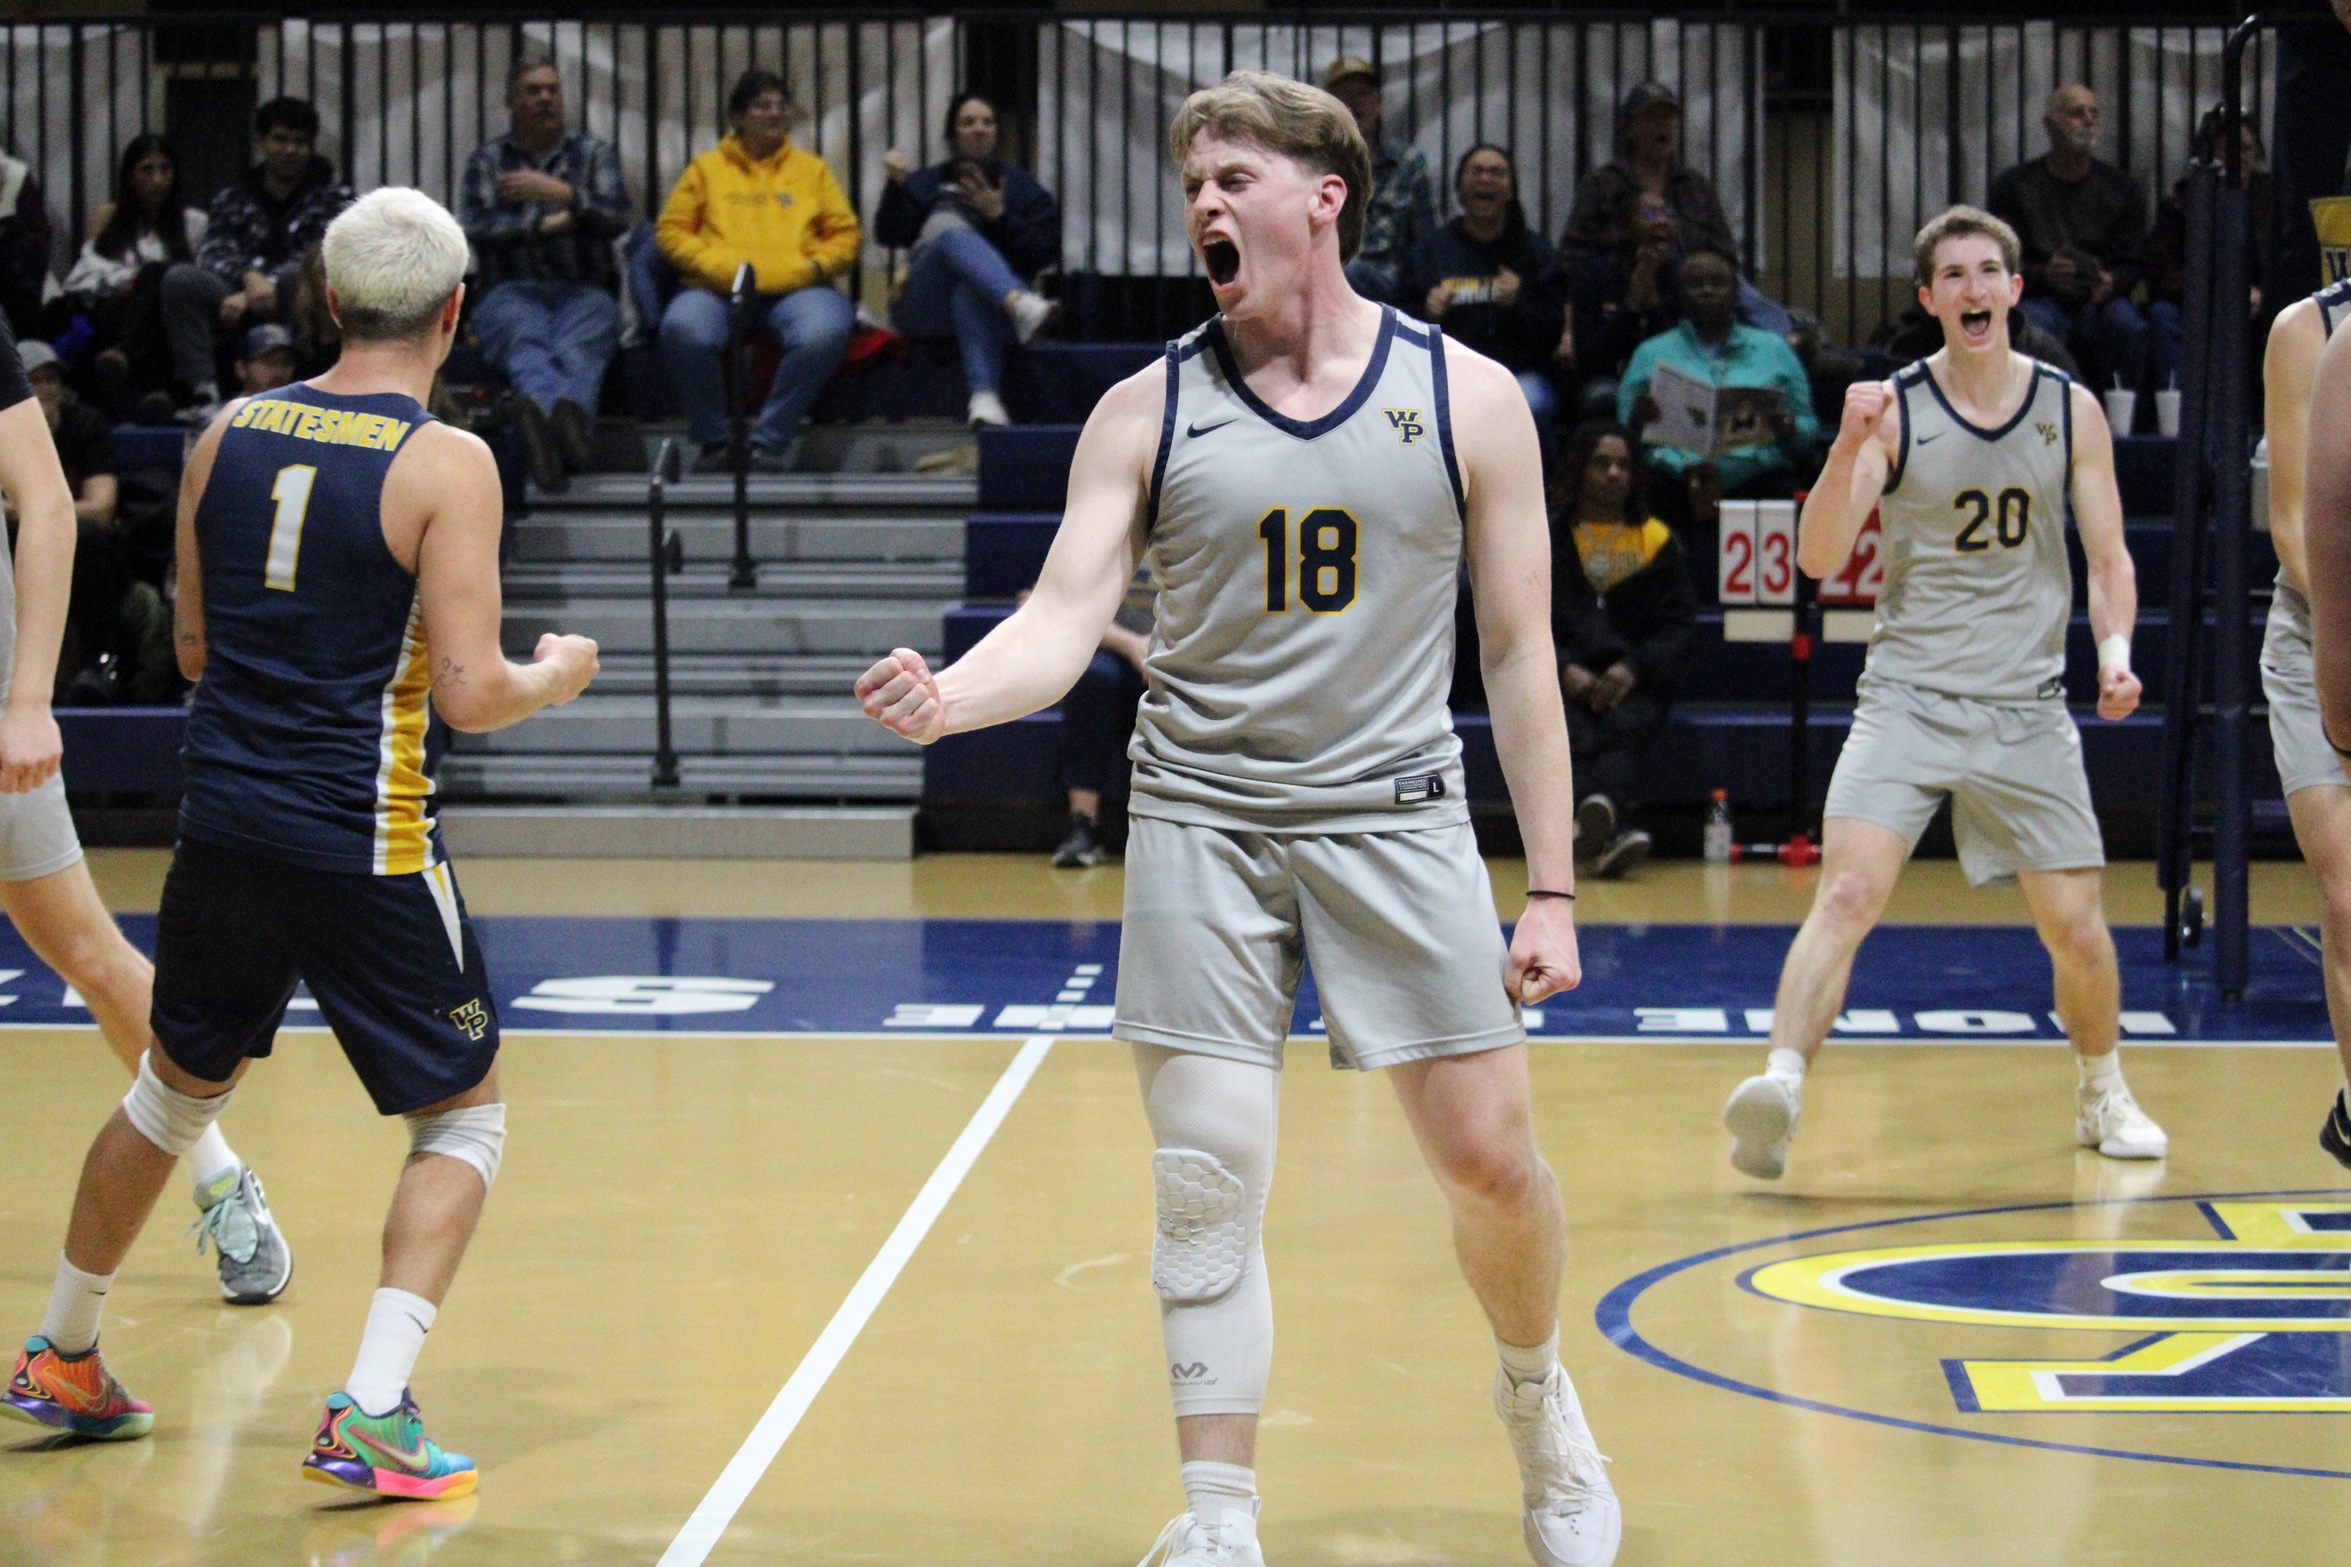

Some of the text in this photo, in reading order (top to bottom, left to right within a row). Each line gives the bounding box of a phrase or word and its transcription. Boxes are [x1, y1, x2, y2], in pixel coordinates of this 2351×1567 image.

[232, 400, 411, 452] STATESMEN
[1381, 407, 1427, 446] WP
[264, 463, 318, 592] 1
[1953, 484, 2033, 555] 20
[1256, 506, 1360, 615] 18
[1725, 531, 1790, 593] 23
[1432, 782, 1440, 793] L
[449, 998, 488, 1041] WP
